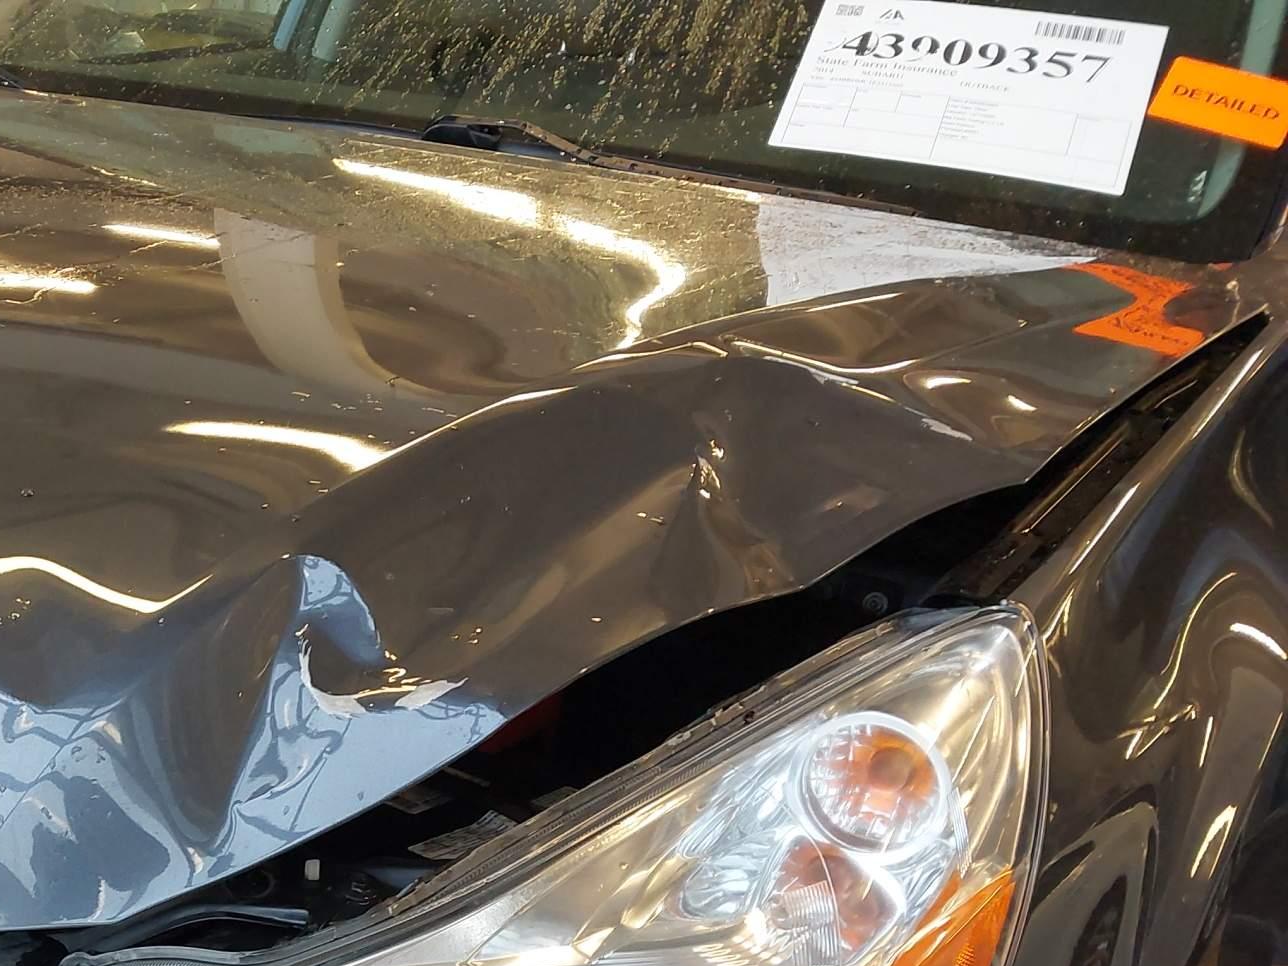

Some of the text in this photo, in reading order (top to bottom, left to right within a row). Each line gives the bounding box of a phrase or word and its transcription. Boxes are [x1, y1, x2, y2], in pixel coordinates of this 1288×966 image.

[816, 55, 849, 67] State
[892, 62, 959, 78] Insurance
[840, 30, 1112, 85] 43909357
[1173, 83, 1280, 121] DETAILED
